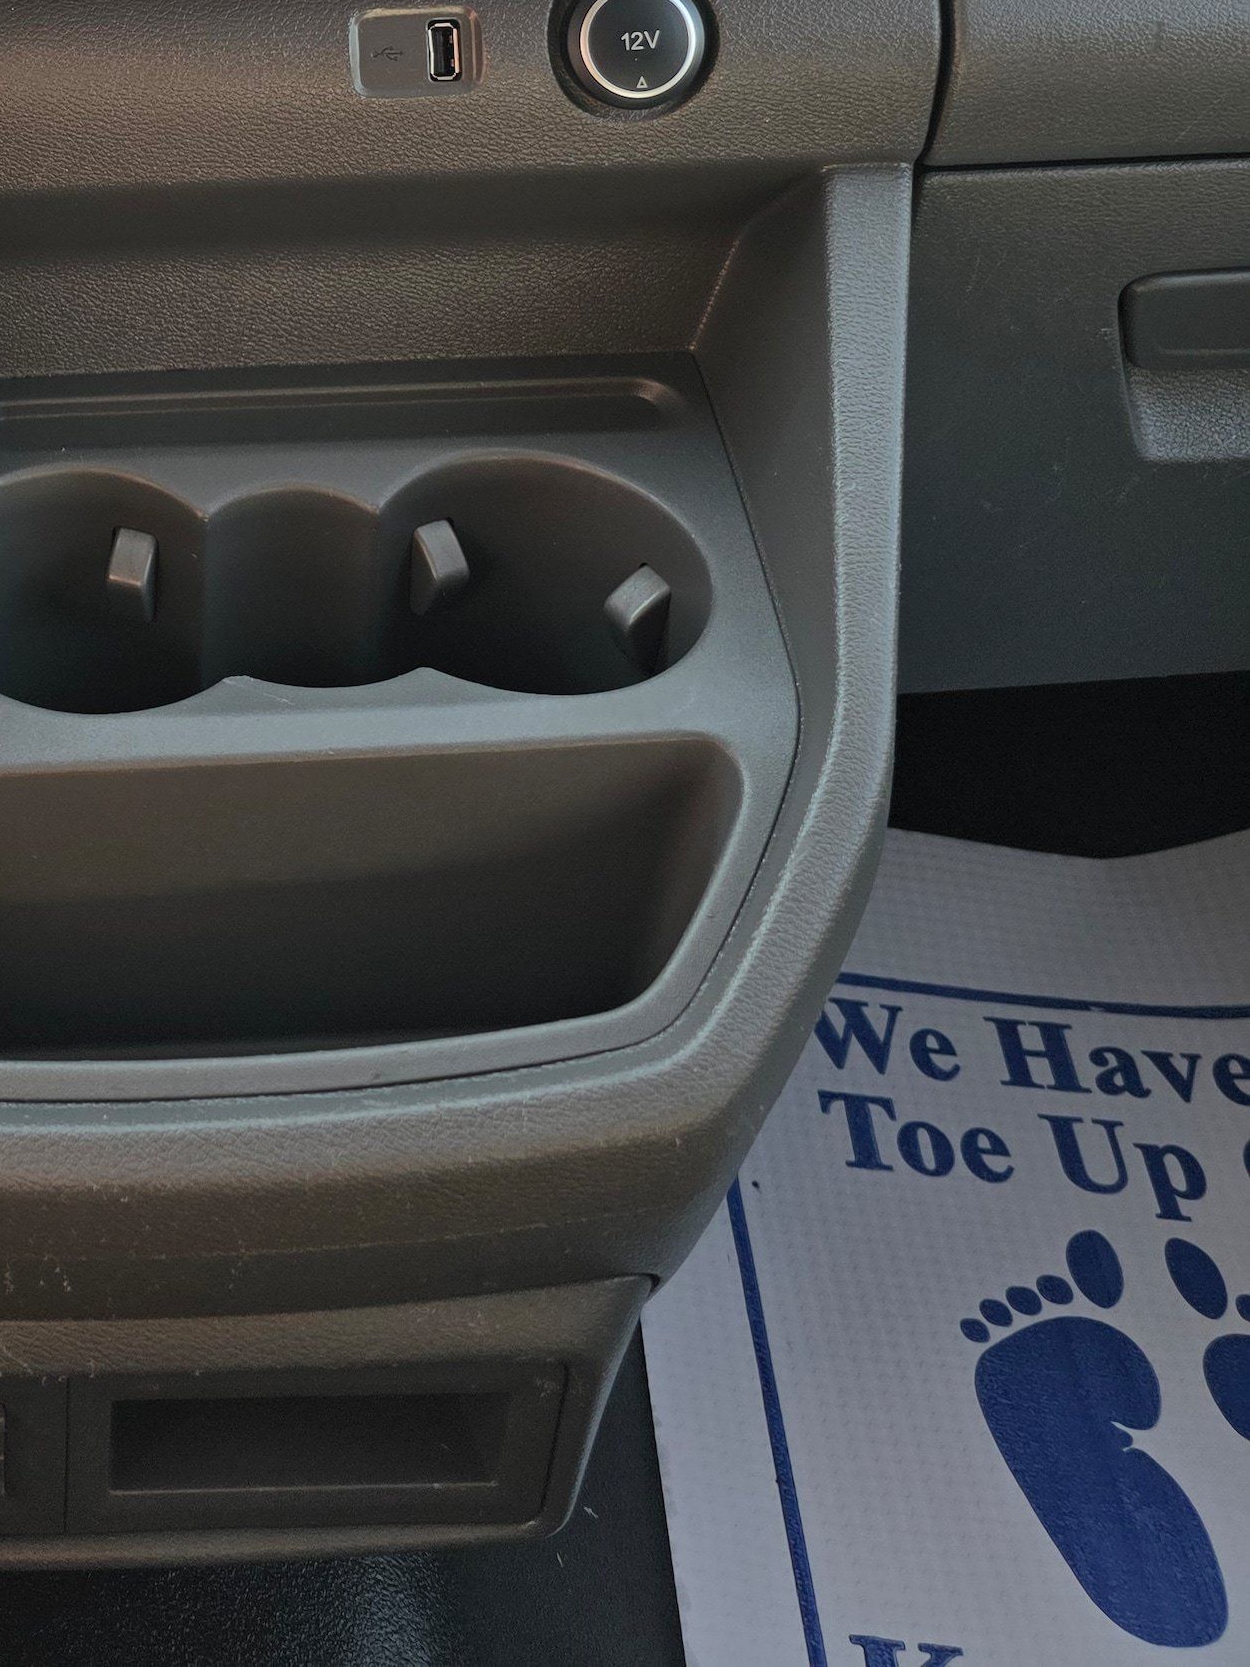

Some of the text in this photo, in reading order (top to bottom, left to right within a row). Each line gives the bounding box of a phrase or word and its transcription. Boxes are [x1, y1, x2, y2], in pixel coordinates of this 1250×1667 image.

[620, 29, 661, 52] 12V
[814, 996, 1250, 1107] We Have
[817, 1089, 1015, 1184] Toe
[1037, 1113, 1208, 1223] Up
